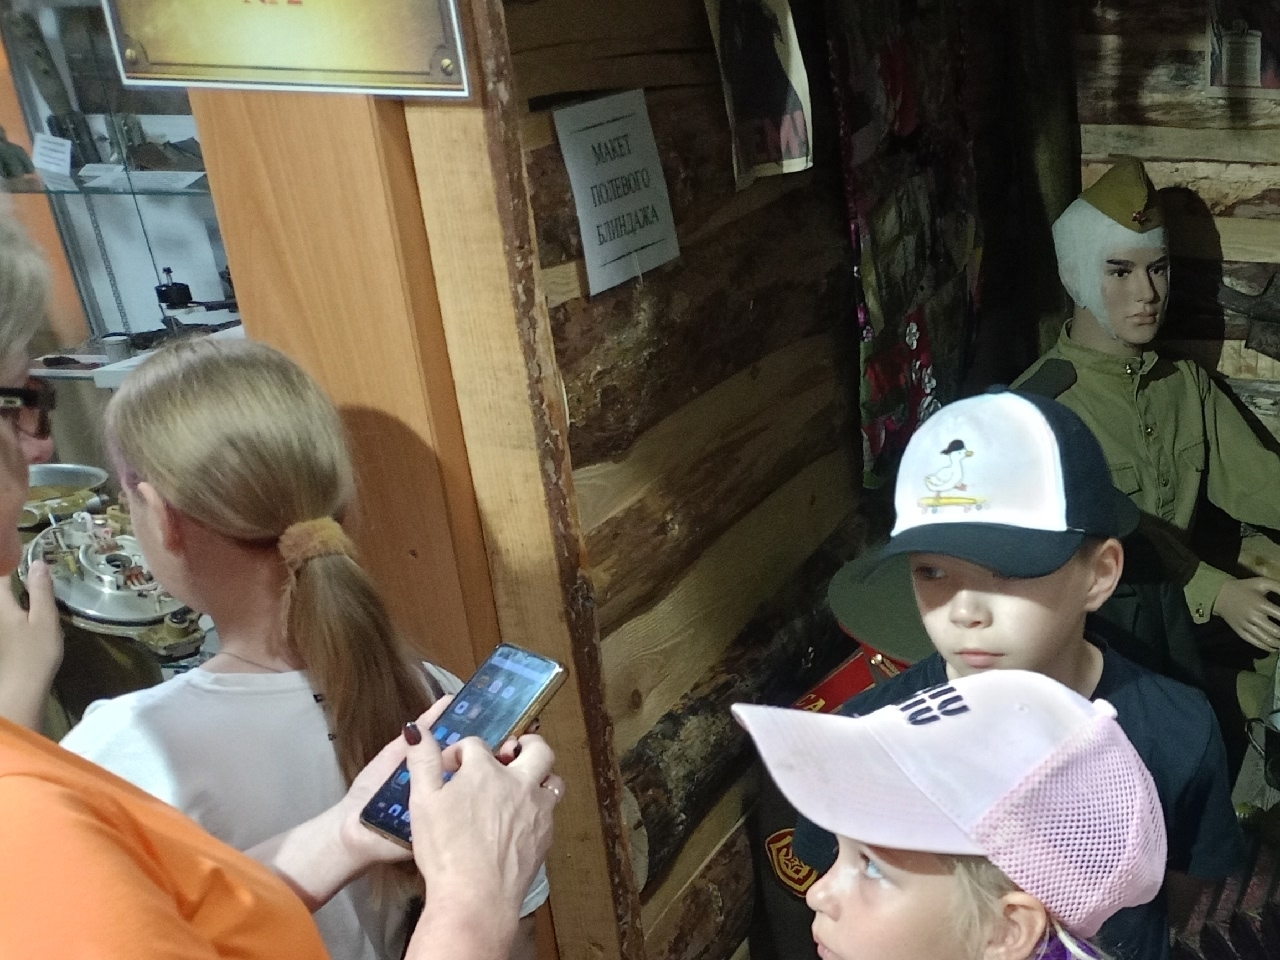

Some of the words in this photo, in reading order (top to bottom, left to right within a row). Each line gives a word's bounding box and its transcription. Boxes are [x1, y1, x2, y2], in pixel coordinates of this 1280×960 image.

[591, 134, 632, 166] МАКЕТ
[590, 168, 650, 208] ПОЛЕВОГО
[596, 203, 659, 246] БЛИНДАЖА
